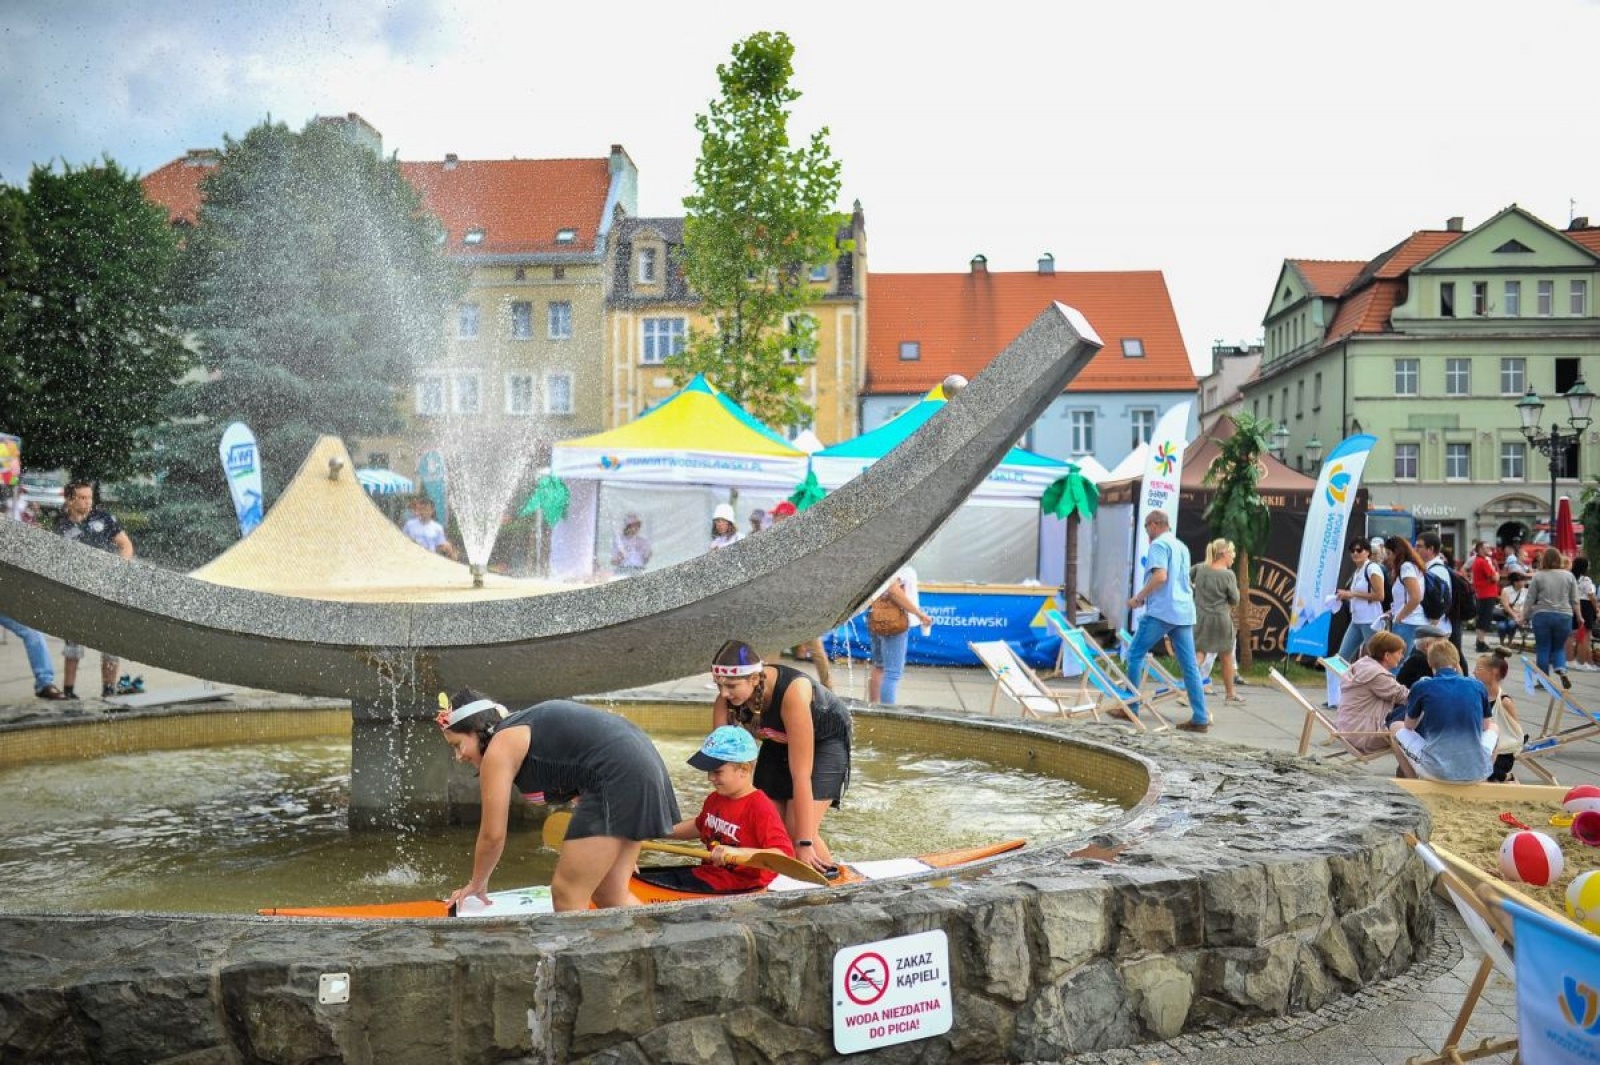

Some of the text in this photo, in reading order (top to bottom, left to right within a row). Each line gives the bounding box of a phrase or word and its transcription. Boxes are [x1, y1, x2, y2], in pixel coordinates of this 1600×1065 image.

[1412, 503, 1457, 518] Kwiaty
[920, 606, 957, 616] OWIAT
[895, 953, 933, 970] ZAKAZ
[896, 968, 939, 988] KĄPIELI
[845, 998, 941, 1027] WODA NIEZDATNA
[869, 1019, 920, 1039] DO PICIA!
